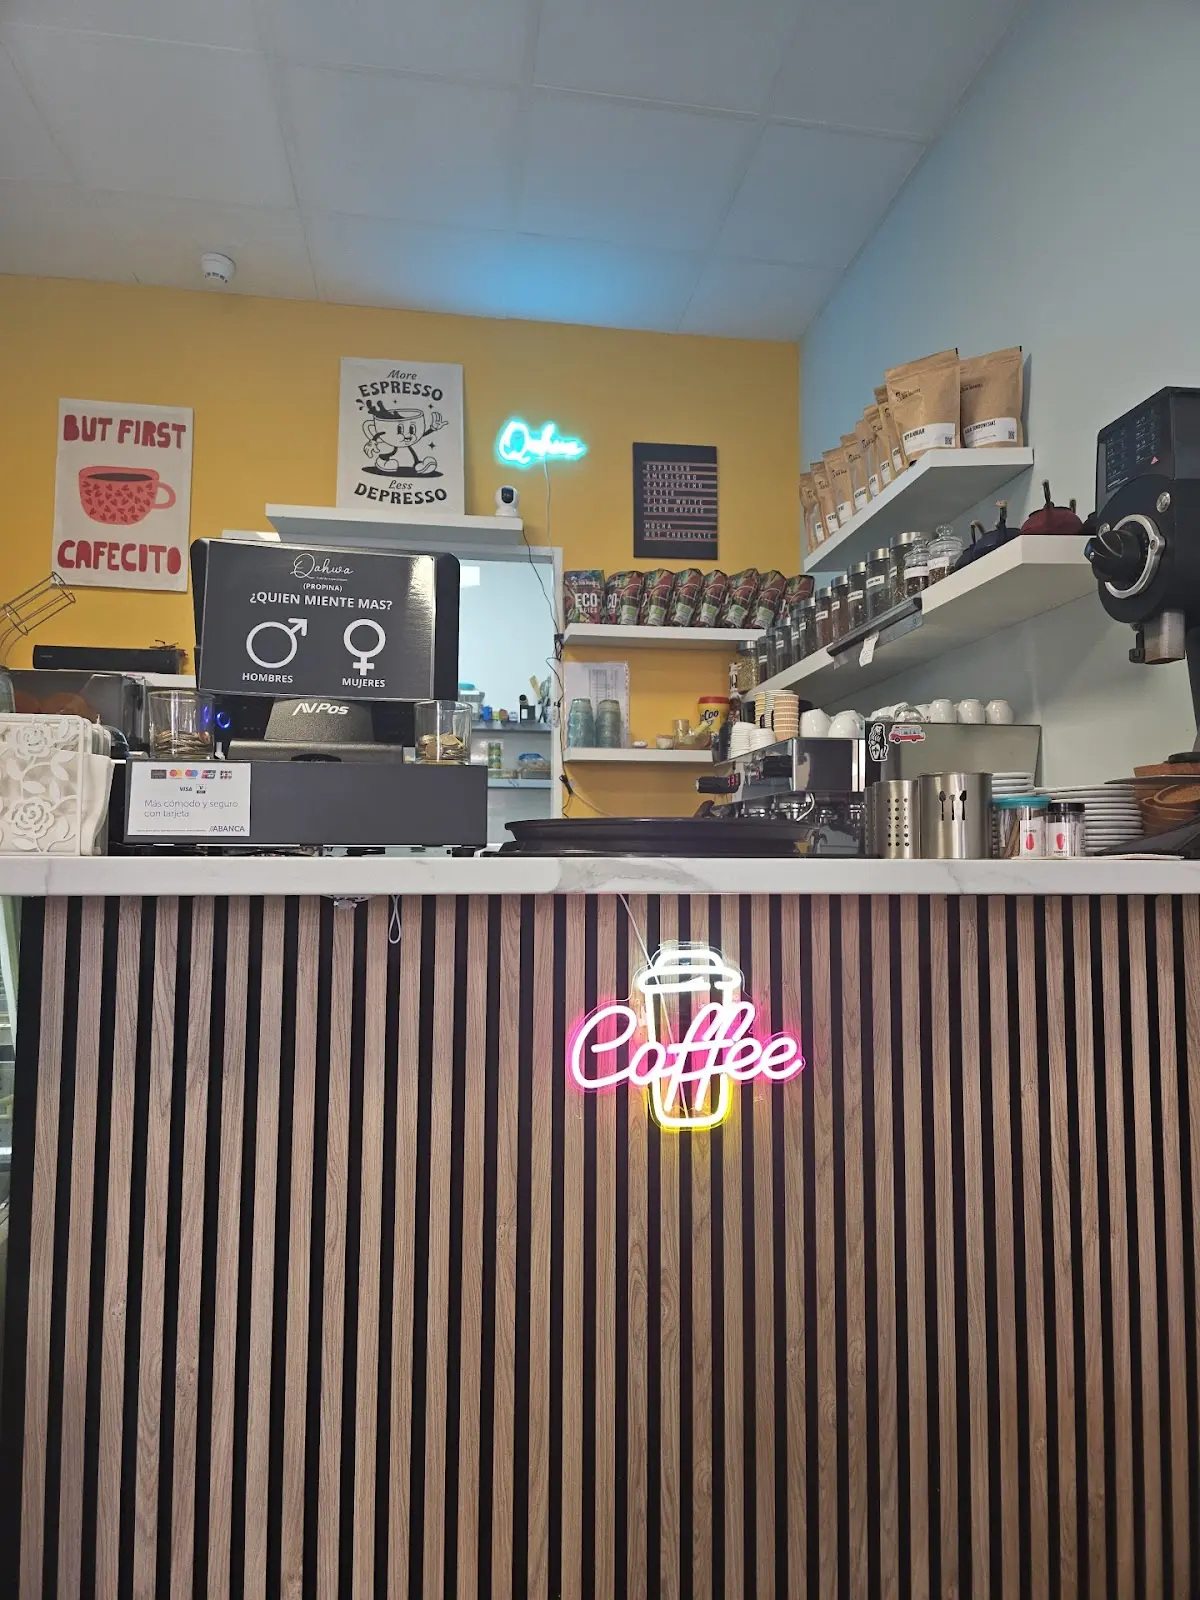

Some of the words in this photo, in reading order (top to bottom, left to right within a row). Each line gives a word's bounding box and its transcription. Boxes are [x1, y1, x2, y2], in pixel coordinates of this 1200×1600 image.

[385, 369, 418, 380] More
[358, 381, 443, 401] ESPRESSO
[63, 414, 113, 443] BUT
[117, 419, 186, 449] FIRST
[388, 480, 413, 490] Less
[354, 482, 447, 504] DEPRESSO
[647, 489, 675, 497] LATTE
[57, 539, 182, 575] CAFECITO
[290, 553, 354, 579] Qahwa
[303, 582, 343, 593] (PROPINA)
[250, 591, 300, 605] ¿QUIEN
[304, 595, 355, 608] MIENTE
[358, 599, 393, 610] MAS?
[575, 592, 598, 608] ECO
[242, 672, 294, 683] HOMBRES
[342, 678, 386, 688] MUJERES
[144, 799, 162, 808] Más
[163, 799, 201, 808] cómodo
[202, 801, 208, 809] y
[209, 801, 239, 809] seguro
[163, 810, 190, 820] tarjeta
[570, 1000, 803, 1112] Coffee
